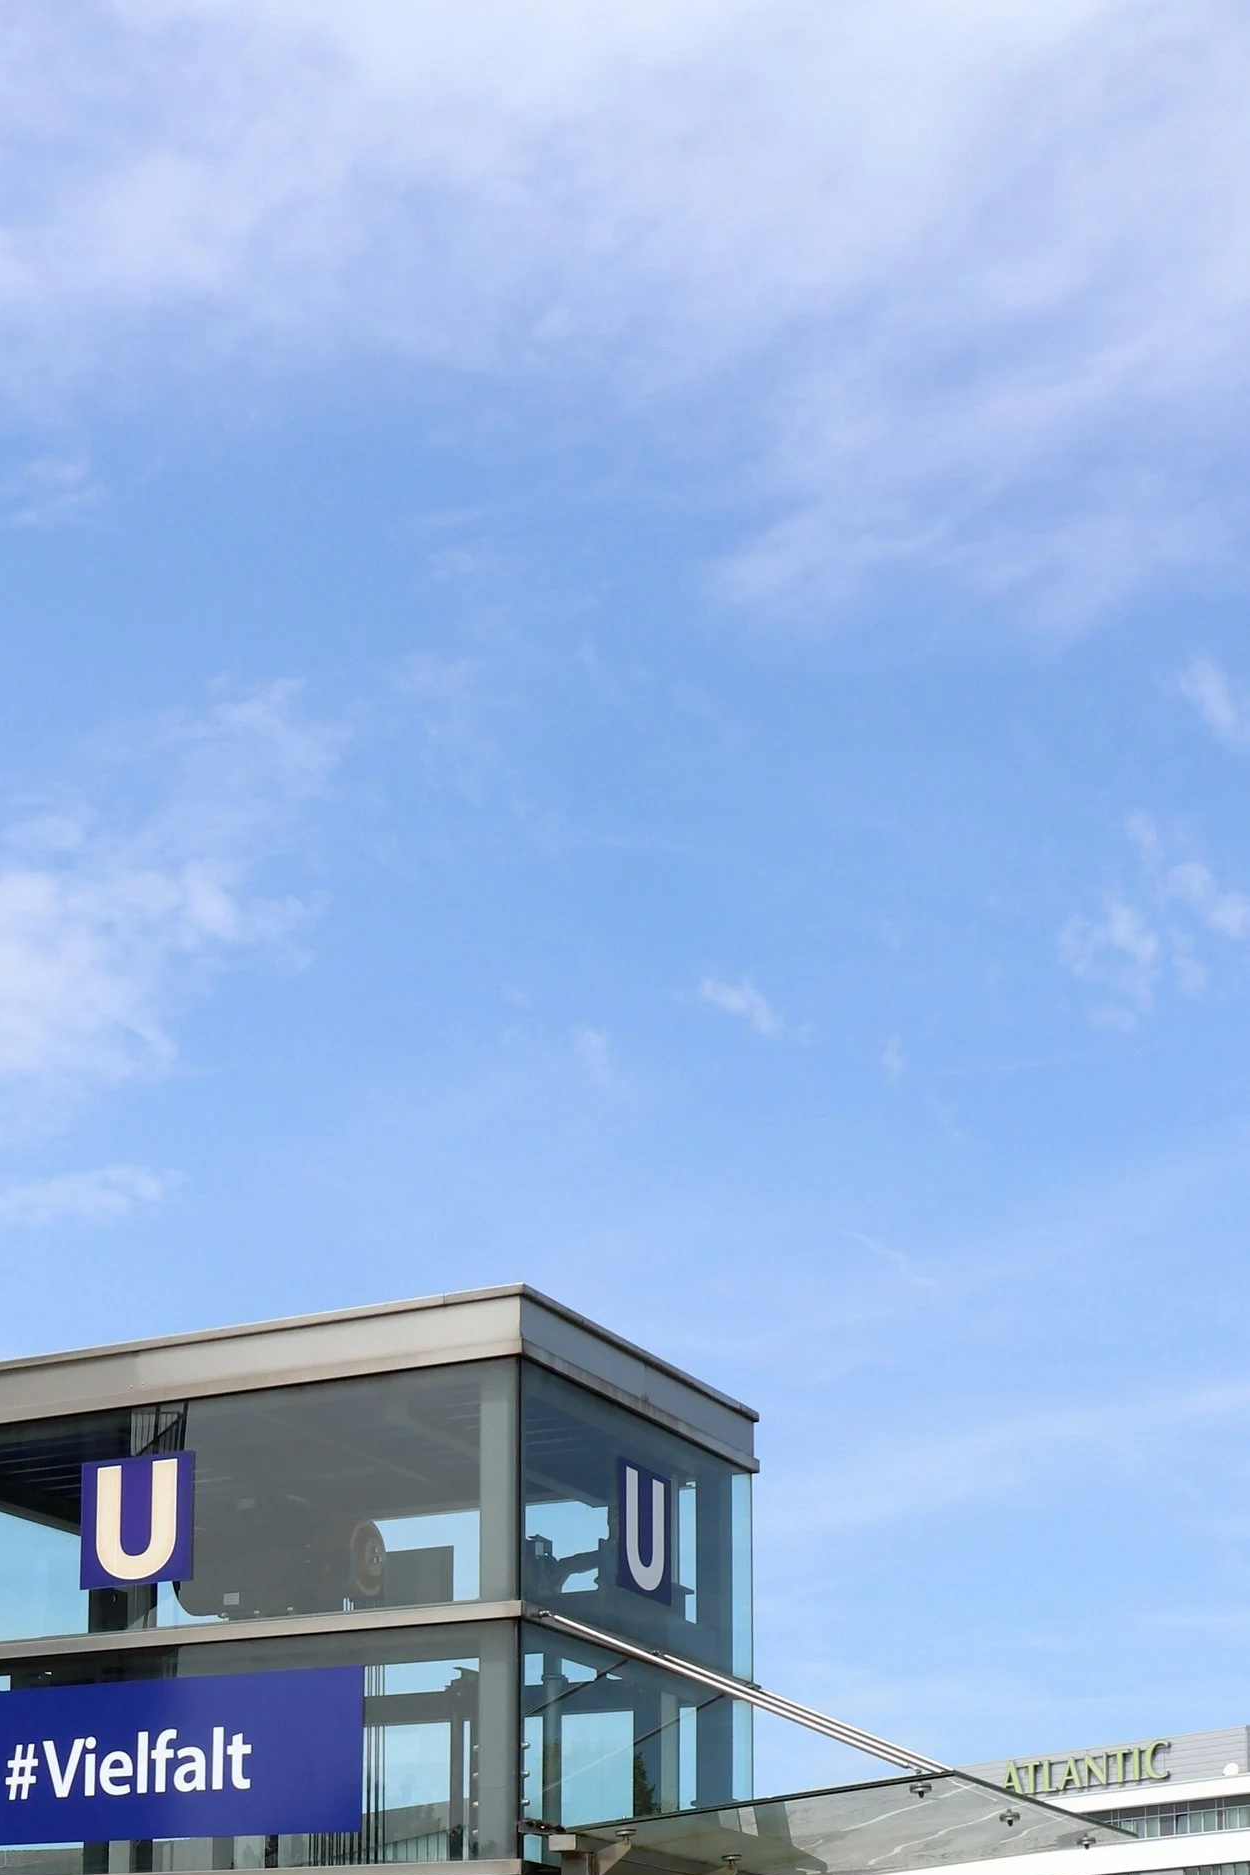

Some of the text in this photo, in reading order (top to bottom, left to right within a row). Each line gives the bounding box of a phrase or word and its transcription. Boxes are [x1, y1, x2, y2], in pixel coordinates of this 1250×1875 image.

[95, 1458, 178, 1580] U
[625, 1465, 665, 1592] U
[4, 1726, 252, 1801] #Vielfalt
[1001, 1738, 1172, 1796] ATLANTIC
